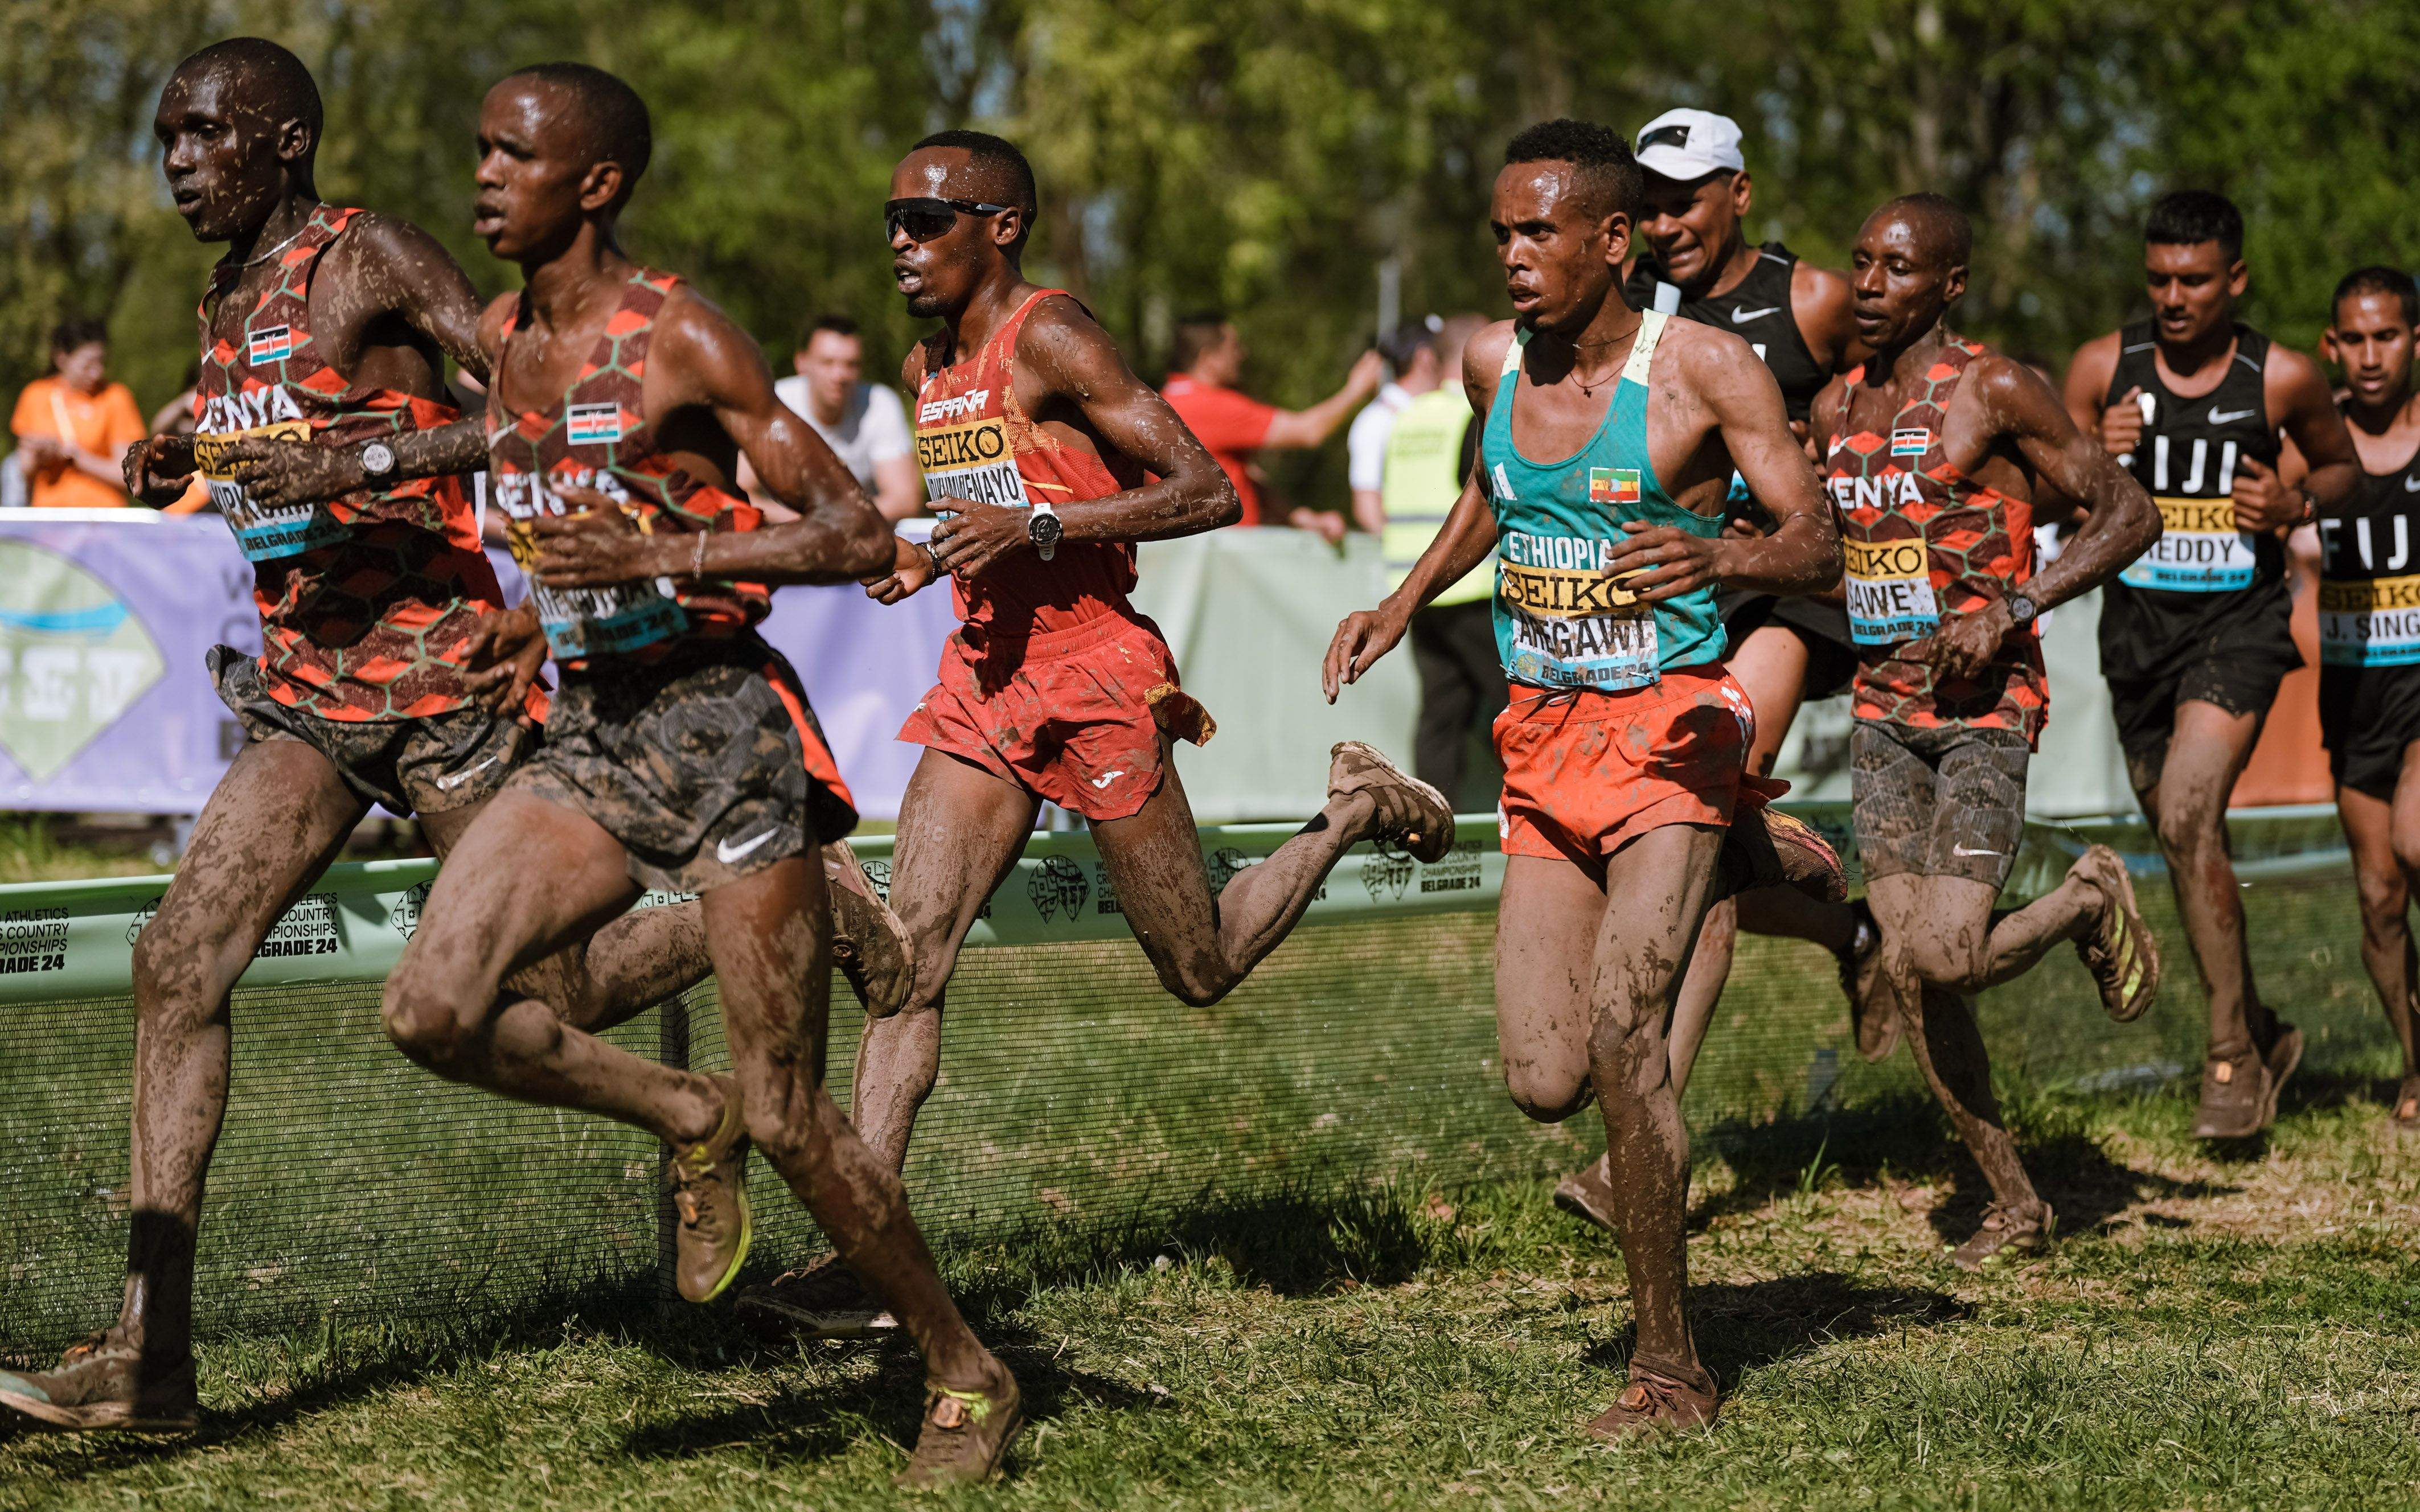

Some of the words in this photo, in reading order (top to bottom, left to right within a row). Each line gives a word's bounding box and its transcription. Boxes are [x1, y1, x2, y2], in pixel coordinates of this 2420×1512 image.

[918, 388, 989, 423] ESPAÑA
[917, 425, 1004, 468] SEIKO
[2116, 435, 2237, 494] IJI
[1509, 531, 1615, 570] ETHIOPIA
[1844, 545, 1921, 574] EIKO
[1848, 581, 1911, 615] SAWE
[5, 907, 69, 923] ATHLETICS
[7, 922, 69, 939] COUNTRY
[315, 938, 338, 954] 24
[41, 954, 65, 971] 24
